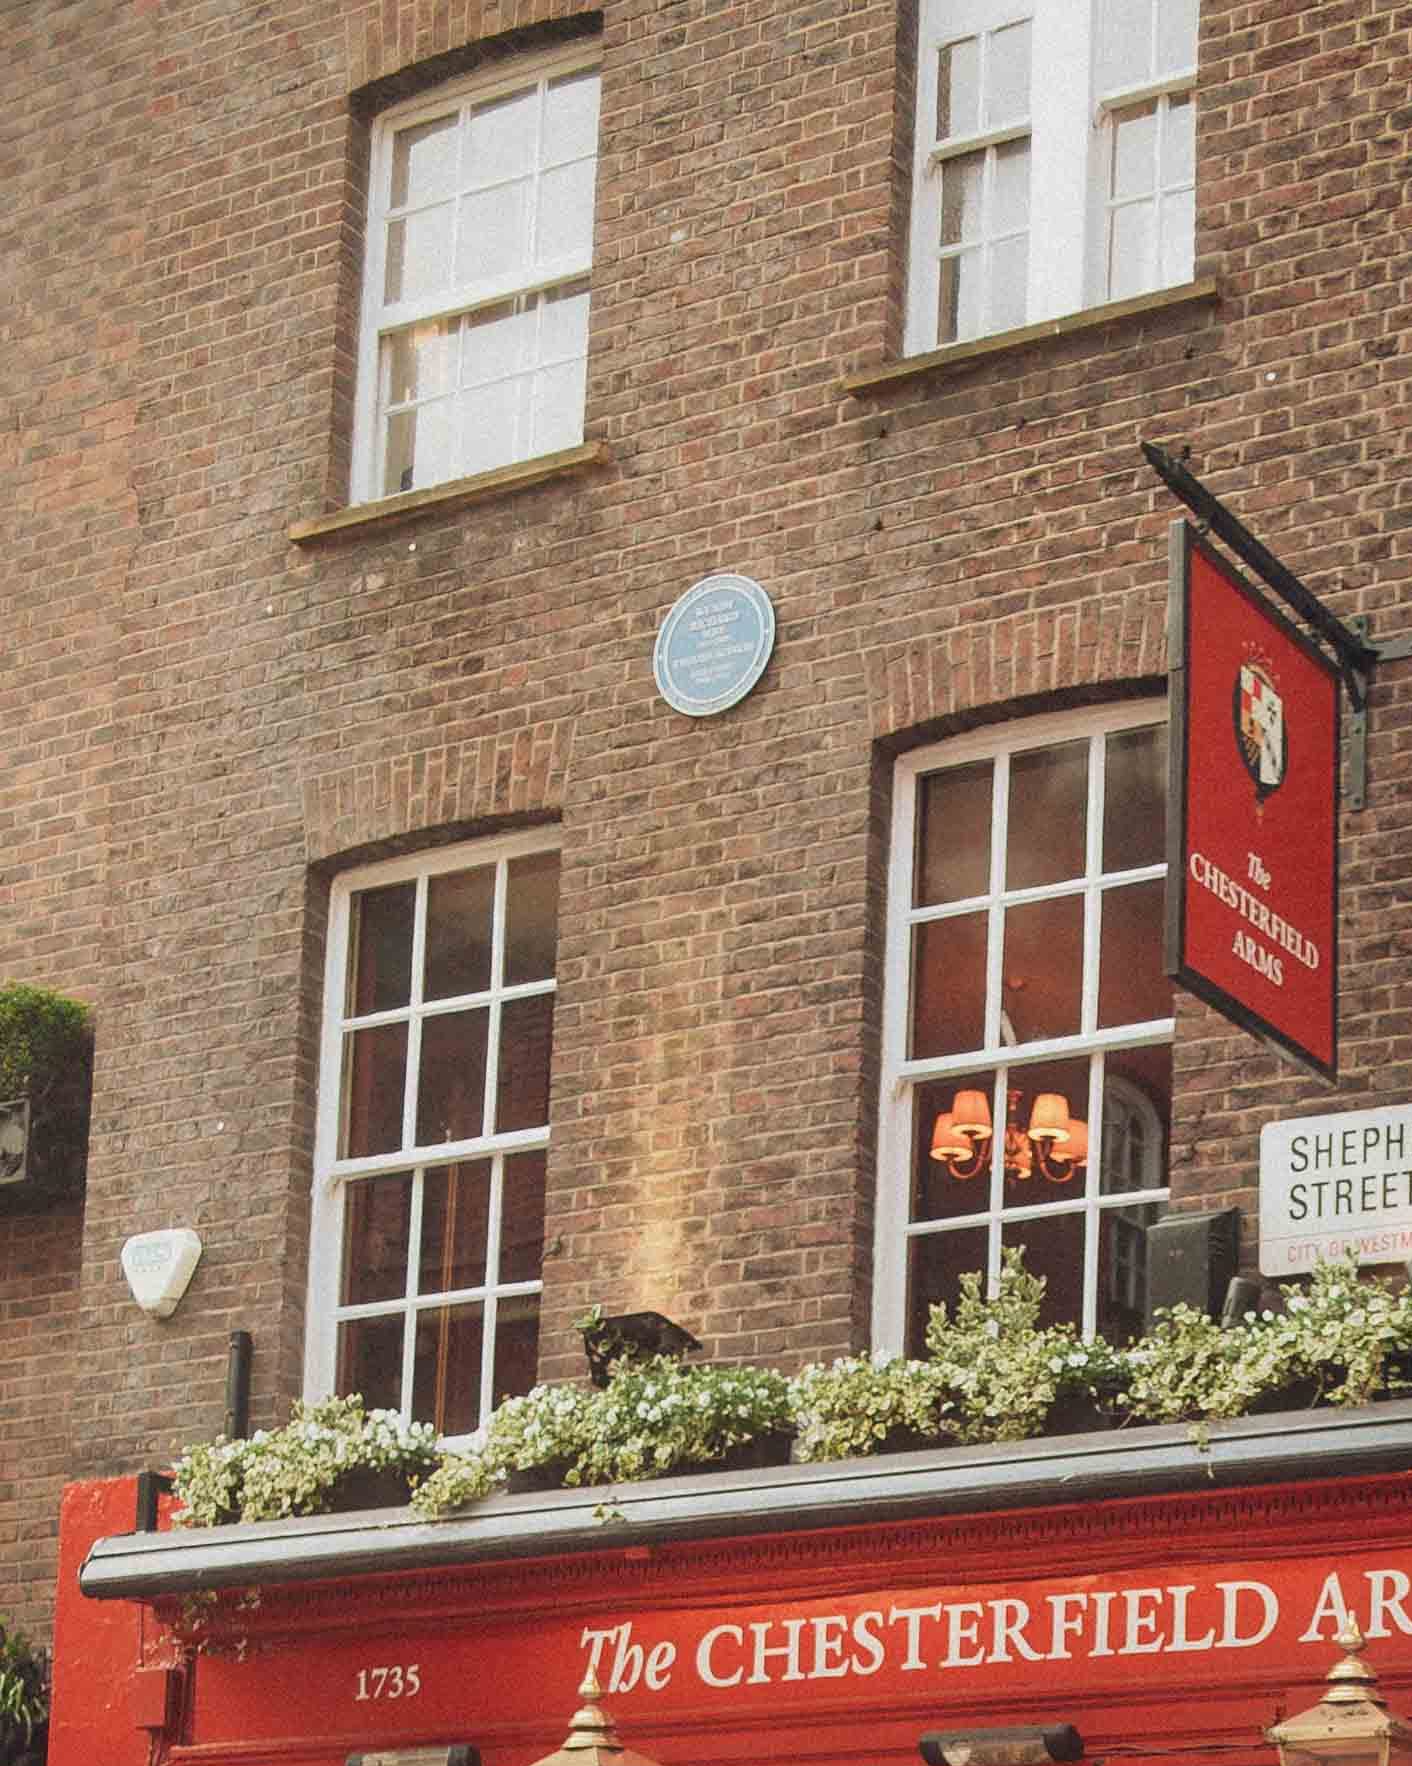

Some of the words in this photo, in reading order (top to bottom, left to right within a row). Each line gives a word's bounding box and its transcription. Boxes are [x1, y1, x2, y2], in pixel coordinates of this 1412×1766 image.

[1246, 851, 1271, 892] The
[1190, 851, 1320, 971] CHESTERFIELD
[1231, 927, 1284, 988] ARMS
[1287, 1241, 1323, 1263] CITY
[580, 1621, 677, 1694] The
[695, 1580, 1280, 1689] CHESTERFIELD
[354, 1664, 420, 1702] 1735
